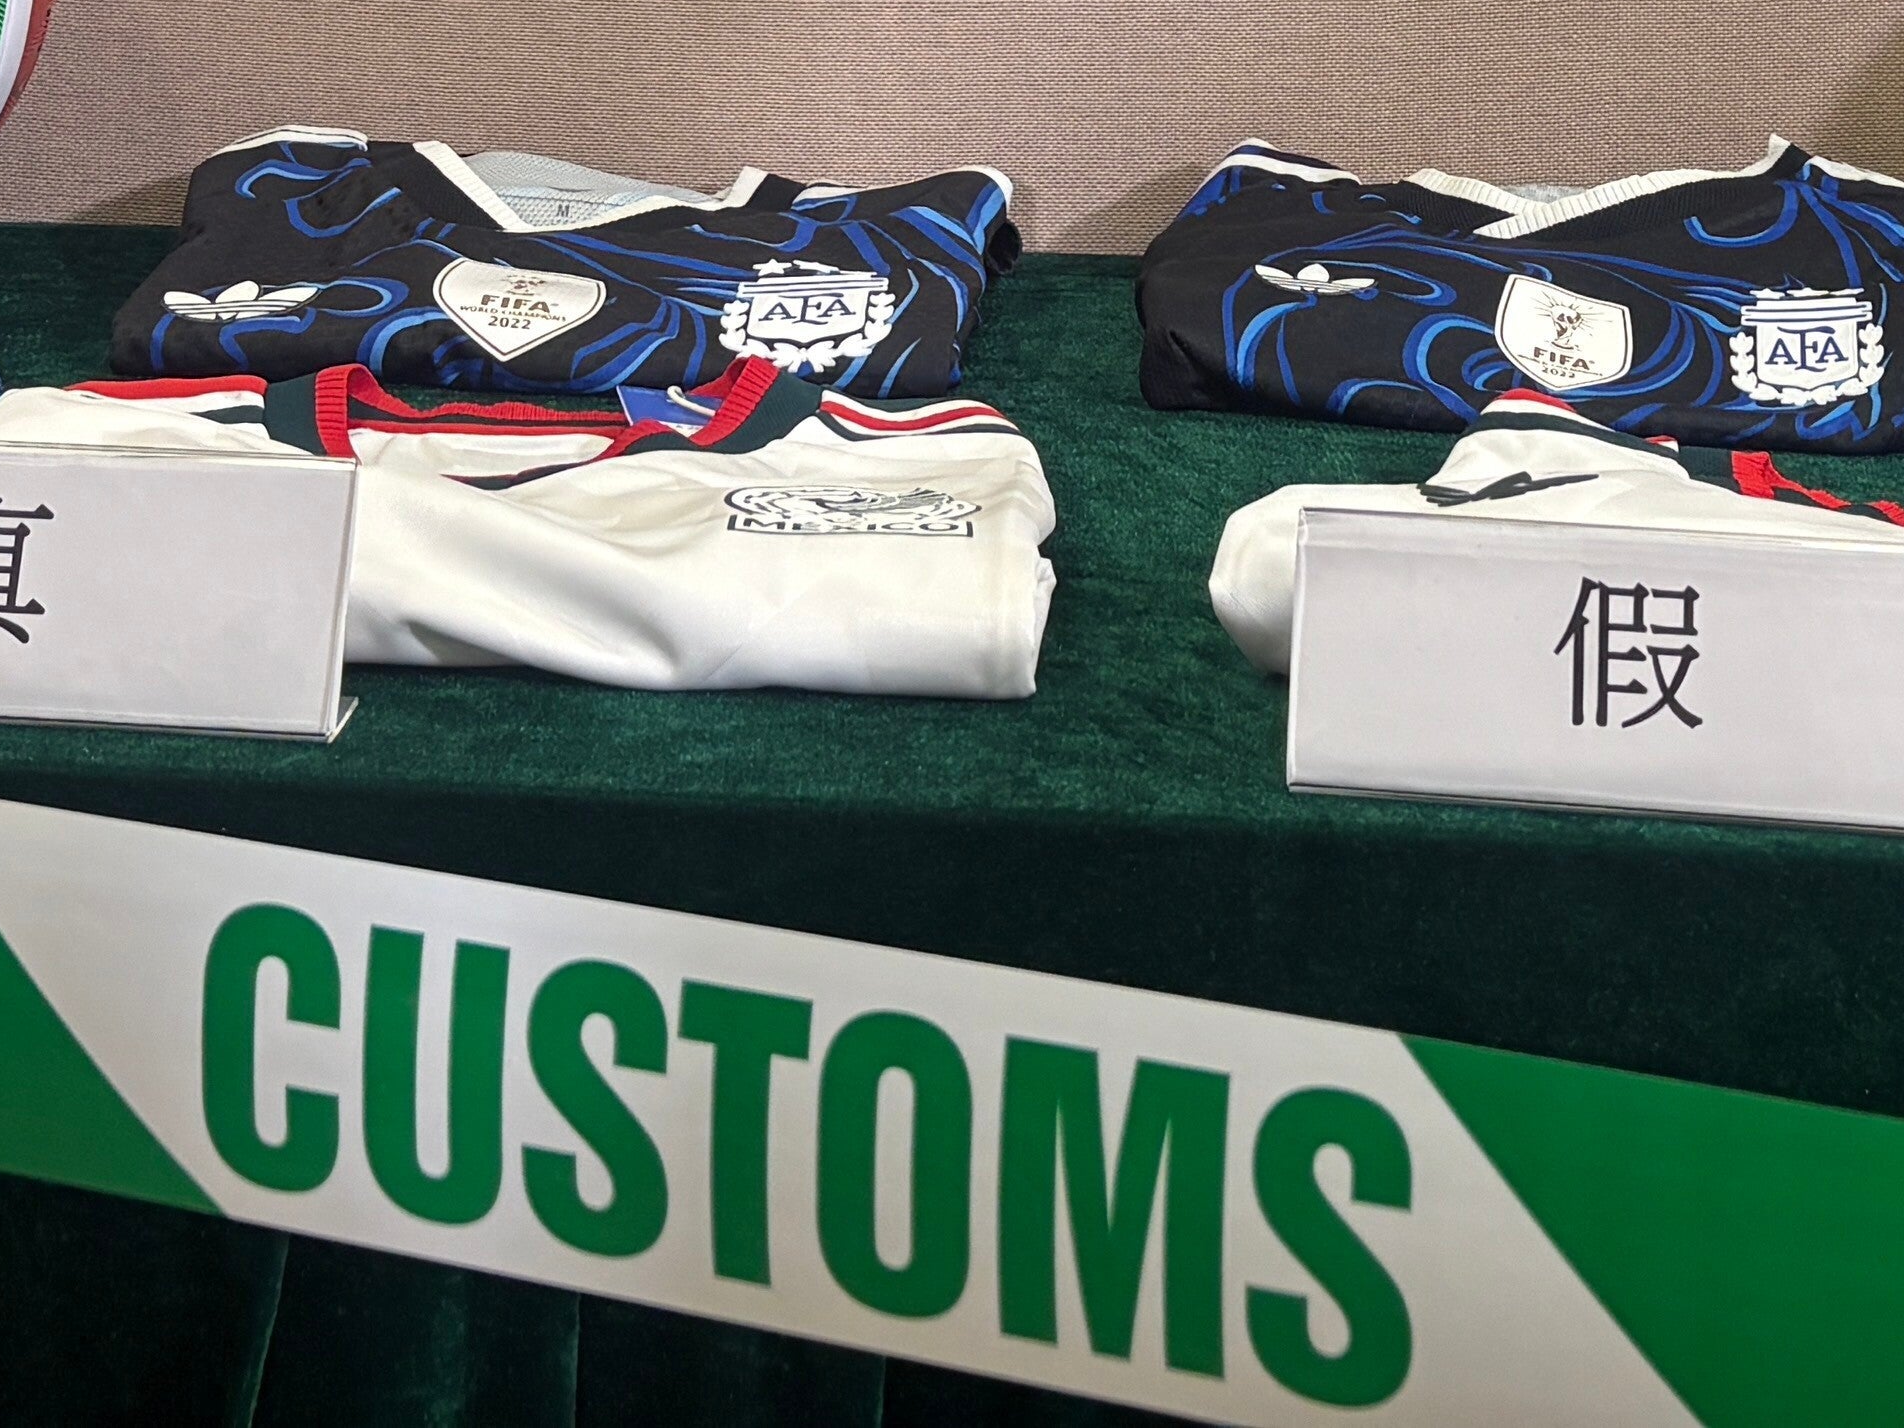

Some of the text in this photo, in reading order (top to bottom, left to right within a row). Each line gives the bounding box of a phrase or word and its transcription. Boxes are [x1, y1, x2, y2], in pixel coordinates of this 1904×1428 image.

[556, 204, 570, 217] M
[459, 305, 499, 315] WORLD
[480, 294, 552, 314] FIFA
[758, 292, 857, 326] AFA
[487, 315, 532, 331] 2022
[1533, 346, 1591, 371] FIFA
[1764, 325, 1850, 373] AFA
[1541, 366, 1576, 379] 2022
[1553, 576, 1704, 730] 假
[199, 900, 1416, 1410] CUSTOMS
